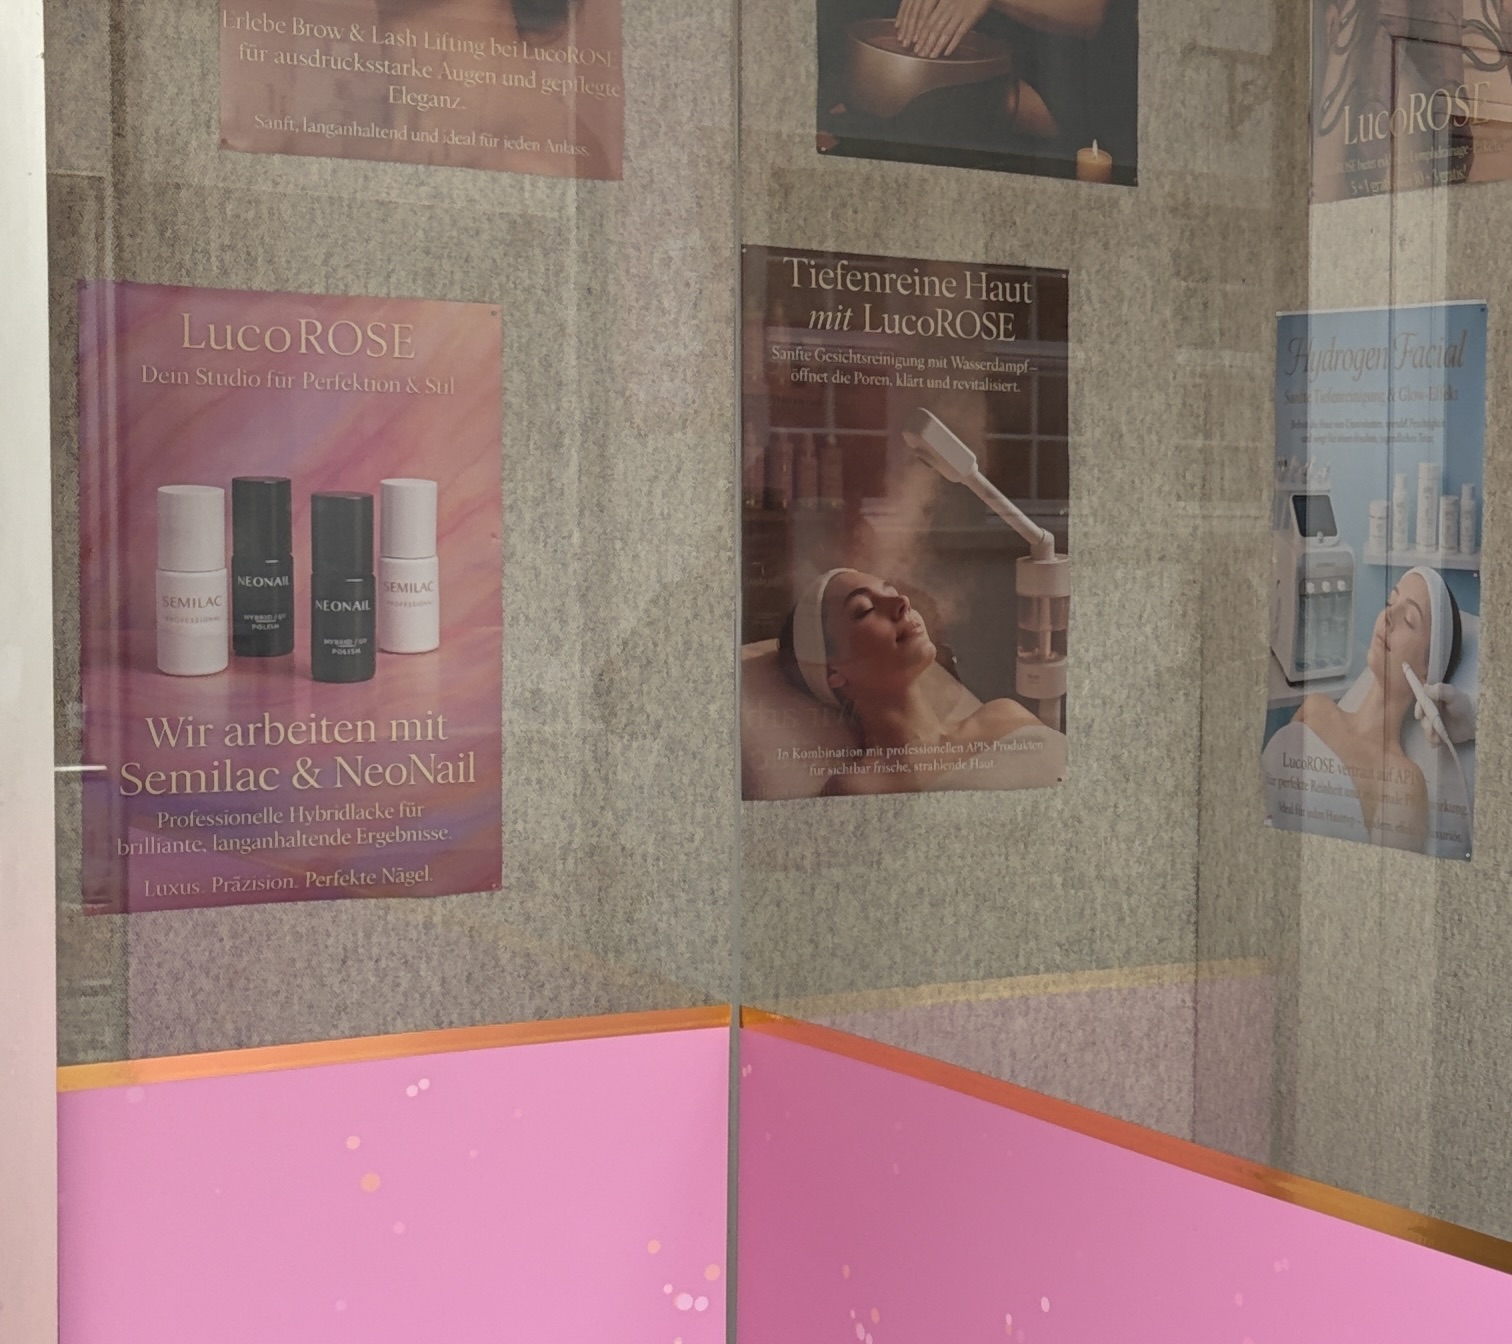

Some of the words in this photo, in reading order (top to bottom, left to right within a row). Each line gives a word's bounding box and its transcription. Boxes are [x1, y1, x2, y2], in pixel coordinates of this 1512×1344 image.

[222, 10, 287, 35] Erlebe
[291, 18, 343, 41] Brow
[349, 22, 366, 42] &
[371, 25, 417, 49] Lash
[423, 31, 485, 59] Lifting
[490, 39, 518, 58] bei
[238, 43, 265, 62] für
[274, 50, 433, 79] ausdrucksstarke
[437, 62, 496, 88] Augen
[503, 69, 536, 89] und
[540, 75, 621, 99] gepflegte
[388, 86, 467, 110] Eleganz.
[1344, 81, 1491, 146] LucoROSE
[254, 114, 299, 133] Sanft,
[302, 117, 408, 141] langanhaltend
[411, 130, 439, 143] und
[442, 130, 476, 146] ideal
[479, 132, 500, 148] für
[503, 137, 540, 152] jeden
[783, 257, 956, 298] Tiefenreine
[964, 271, 1033, 304] Haut
[181, 312, 415, 360] LucoROSE
[808, 306, 854, 332] mit
[863, 304, 1016, 342] LucoROSE
[1284, 336, 1389, 382] Hydrogen
[1392, 329, 1468, 370] Facial
[141, 364, 189, 385] Dein
[196, 368, 260, 388] Studio
[267, 370, 296, 389] für
[303, 371, 400, 394] Perfektion
[405, 376, 421, 394] &
[425, 377, 455, 395] Stil
[790, 368, 827, 383] öffnet
[831, 372, 851, 384] die
[854, 371, 893, 386] Poren,
[896, 373, 924, 388] klärt
[927, 376, 949, 389] und
[952, 378, 1021, 393] revitalisiert.
[237, 576, 289, 587] NEONAIL
[383, 581, 434, 593] SEMILAC
[162, 595, 222, 609] SEMILAC
[315, 599, 370, 612] NEONAIL
[144, 716, 214, 749] Wir
[224, 712, 376, 747] arbeiten
[389, 711, 449, 742] mit
[119, 760, 280, 797] Semilac
[291, 757, 322, 789] &
[334, 752, 476, 788] NeoNail
[1283, 752, 1335, 774] LucoROSE
[157, 807, 284, 829] Professionelle
[289, 803, 394, 825] Hybridlacke
[399, 801, 425, 818] für
[117, 834, 207, 857] brilliante,
[212, 828, 352, 854] langanhaltende
[356, 826, 453, 848] Ergebnisse.
[211, 874, 299, 893] Präzision.
[305, 870, 377, 888] Perfekte
[381, 866, 434, 886] Nägel.
